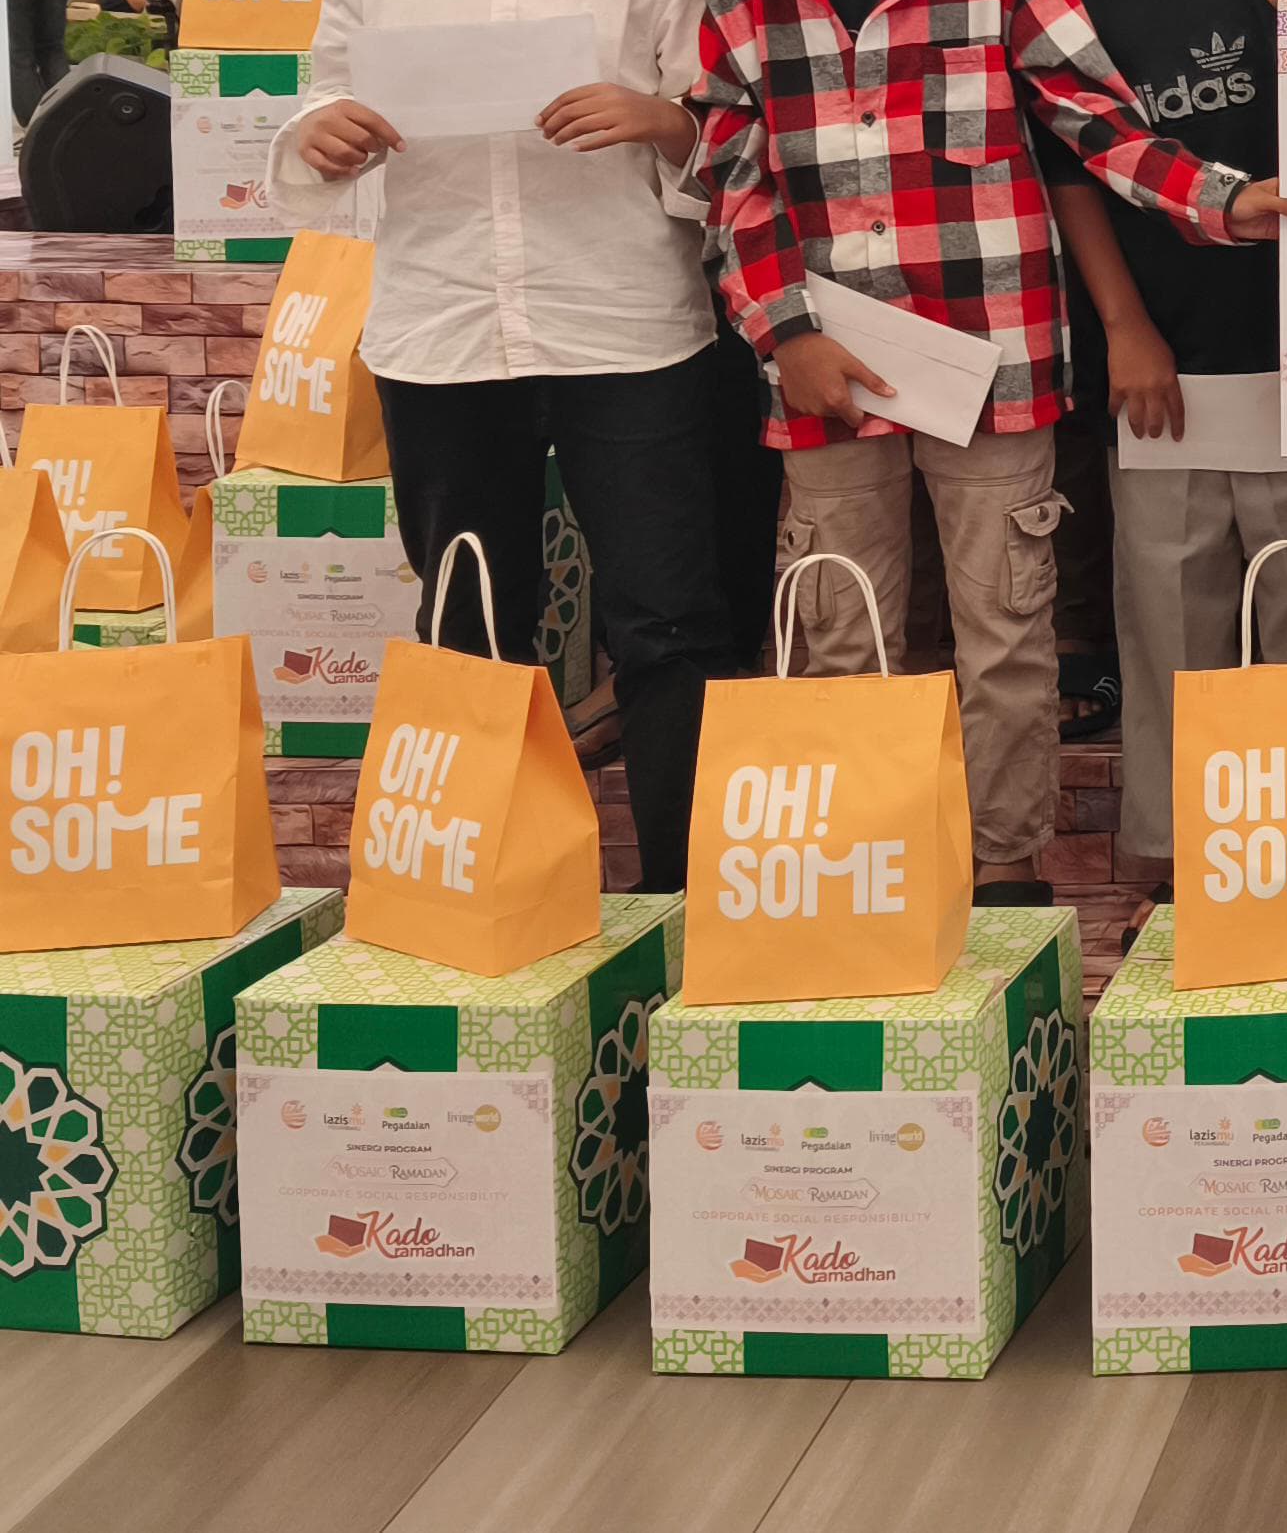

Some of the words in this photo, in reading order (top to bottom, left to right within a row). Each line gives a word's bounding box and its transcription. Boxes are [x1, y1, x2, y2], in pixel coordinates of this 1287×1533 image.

[1135, 72, 1256, 123] idas
[272, 291, 328, 349] OH!
[259, 347, 337, 415] SOME
[58, 509, 128, 558] ME
[306, 646, 370, 684] Kado
[334, 671, 380, 684] ramadh
[10, 725, 125, 801] OH!
[379, 723, 460, 805] OH!
[722, 763, 837, 841] OH!
[10, 793, 203, 874] SOME
[364, 798, 481, 893] SOME
[718, 839, 905, 920] SOME
[764, 1165, 800, 1174] SINERGI
[803, 1166, 853, 1175] PROGRAM
[801, 1140, 851, 1152] Pegadaian
[1213, 1159, 1252, 1167] SINERGI
[357, 1210, 440, 1259] Kado
[693, 1211, 769, 1222] CORPORATE
[774, 1213, 818, 1224] SOCIAL
[824, 1212, 931, 1224] RESPONSIBILITY
[1138, 1206, 1218, 1217] CORPORATE
[1224, 1205, 1271, 1216] SOCIAL
[394, 1243, 475, 1258] ramadhan
[774, 1234, 860, 1284] Kado
[811, 1268, 896, 1283] ramadhan
